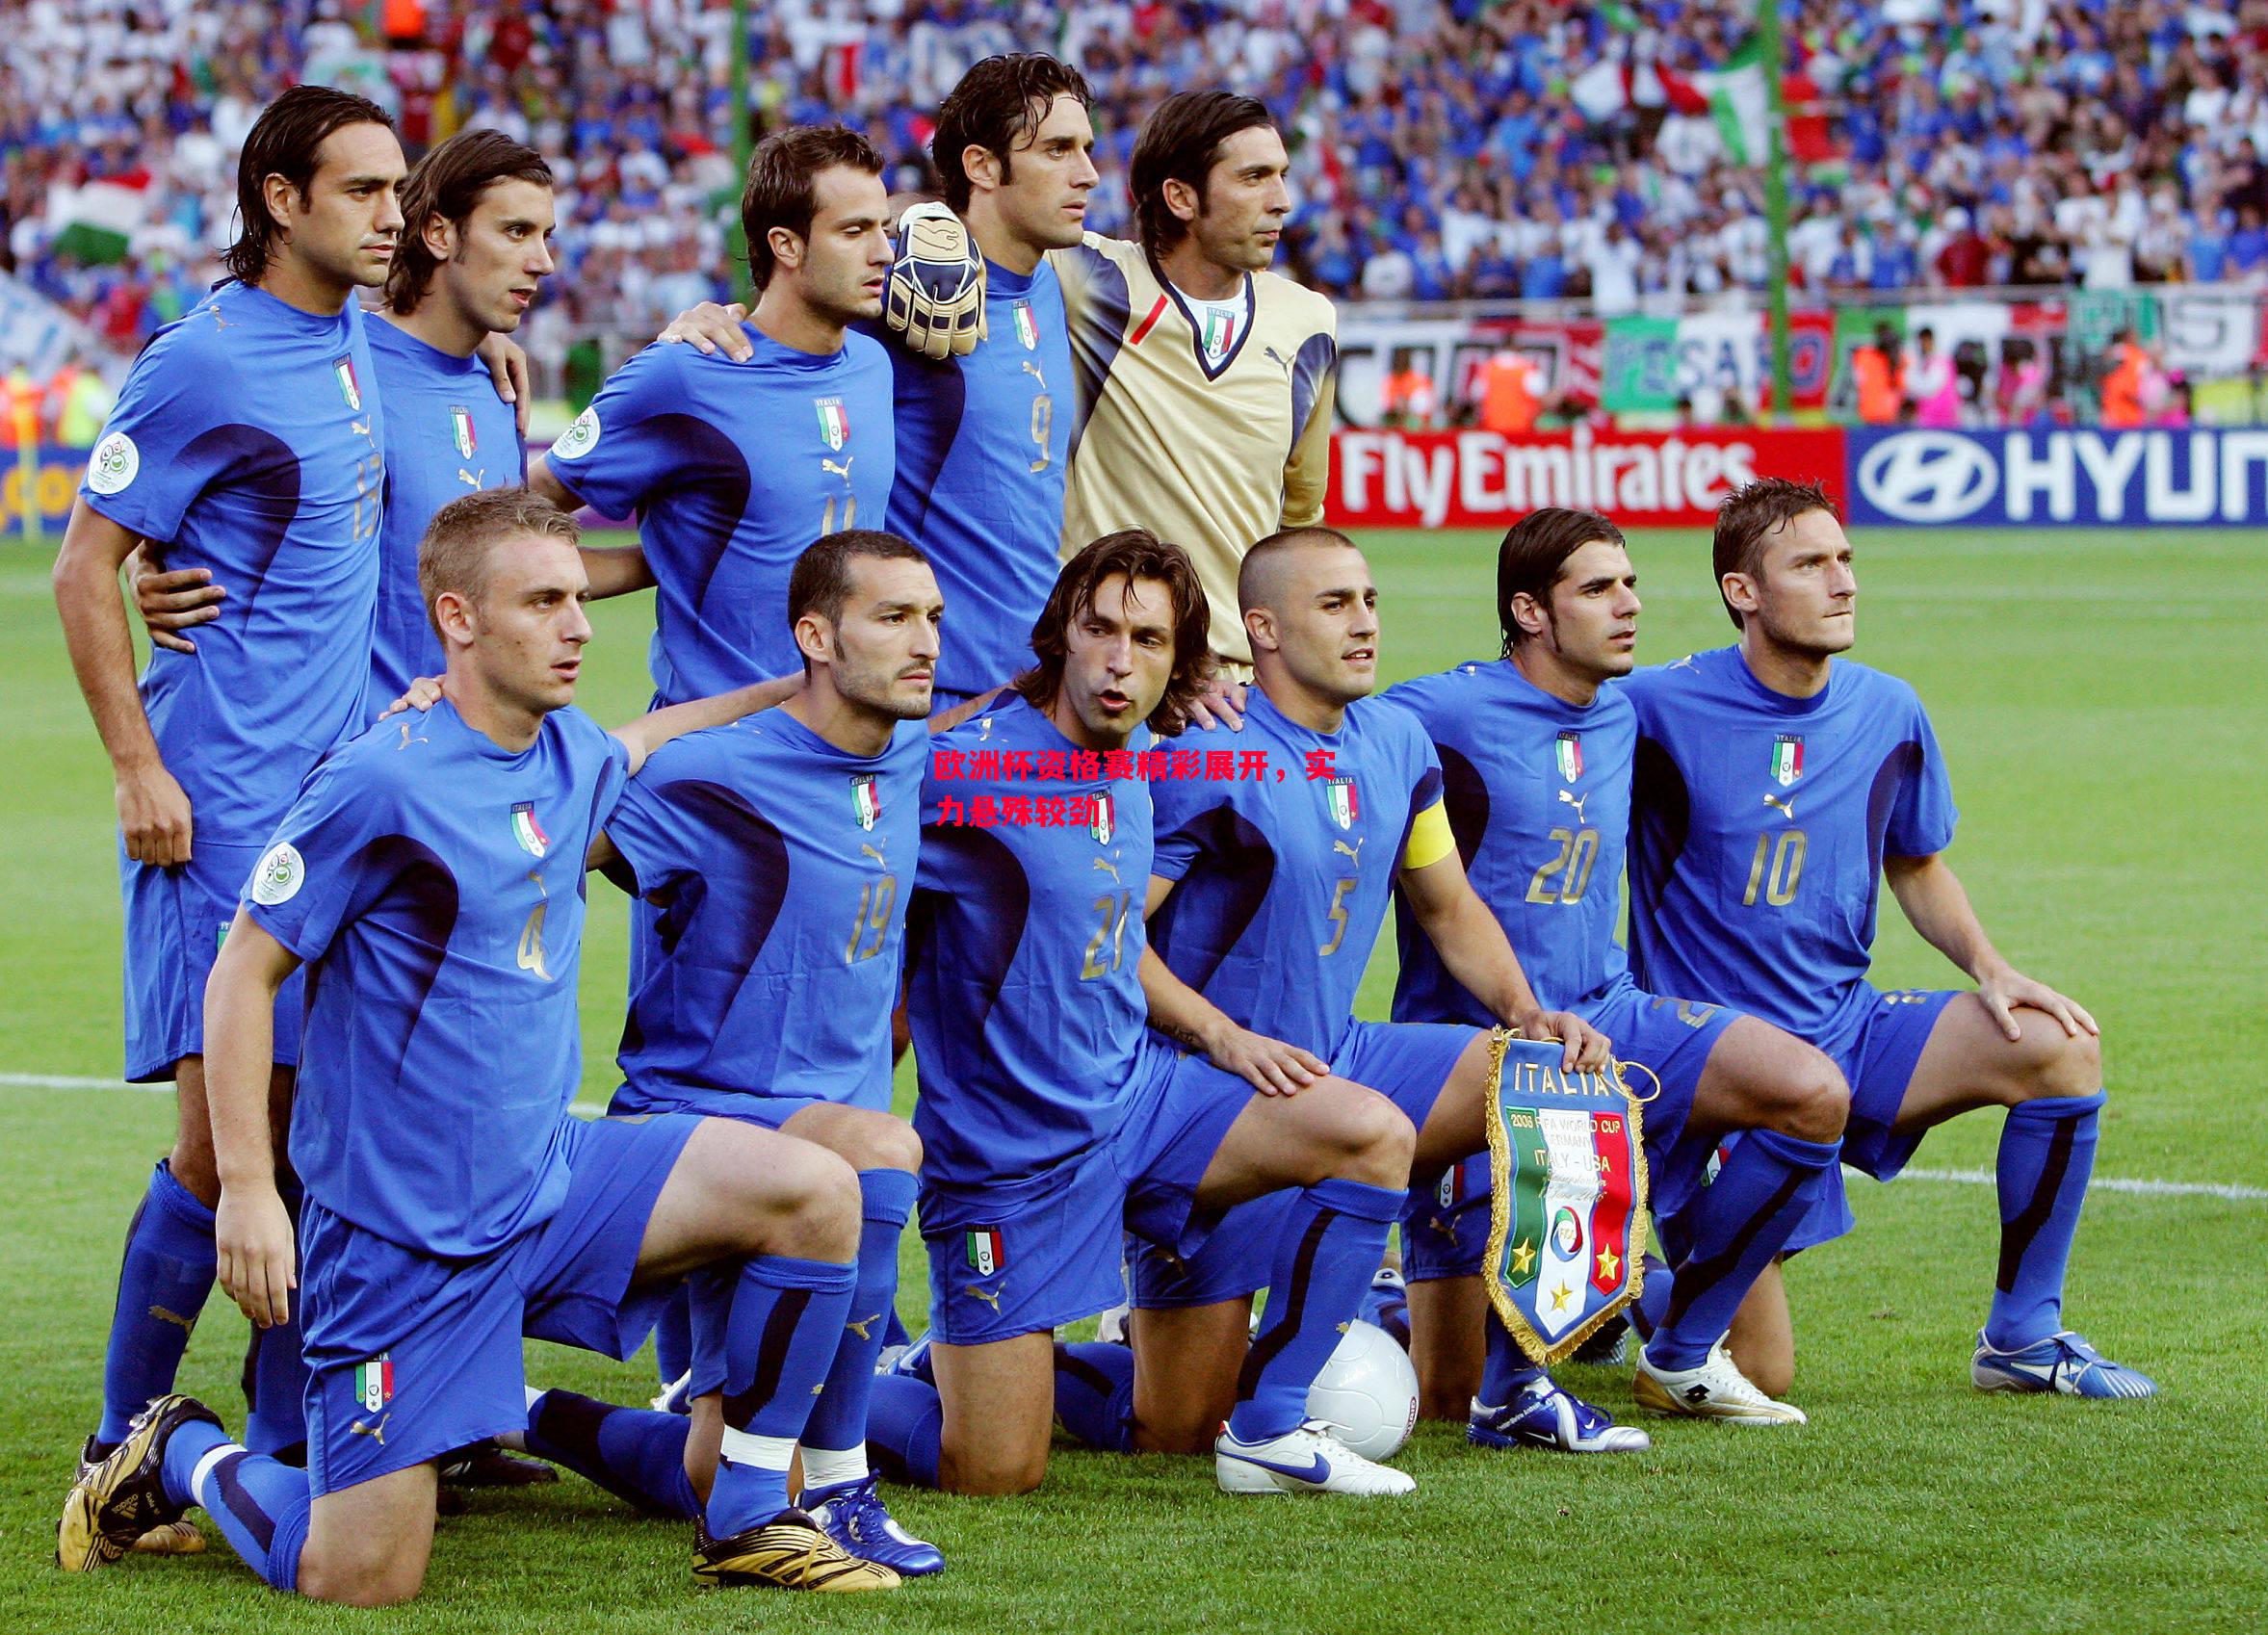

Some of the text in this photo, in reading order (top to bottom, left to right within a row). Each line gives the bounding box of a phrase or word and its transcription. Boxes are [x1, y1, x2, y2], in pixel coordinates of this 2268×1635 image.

[1030, 395, 1051, 473] 9
[1339, 416, 1758, 527] Fly Emirates
[1525, 827, 1601, 905] 20
[1741, 829, 1807, 906] 10
[517, 901, 554, 981] 4
[846, 874, 897, 964] 19
[1080, 890, 1130, 981] 21
[1318, 878, 1359, 956] 5
[1514, 1062, 1610, 1097] ITALIA
[1510, 1114, 1533, 1129] 2006
[1601, 1120, 1621, 1134] CUP
[1534, 1149, 1570, 1168] ITALY
[1583, 1154, 1611, 1173] USA
